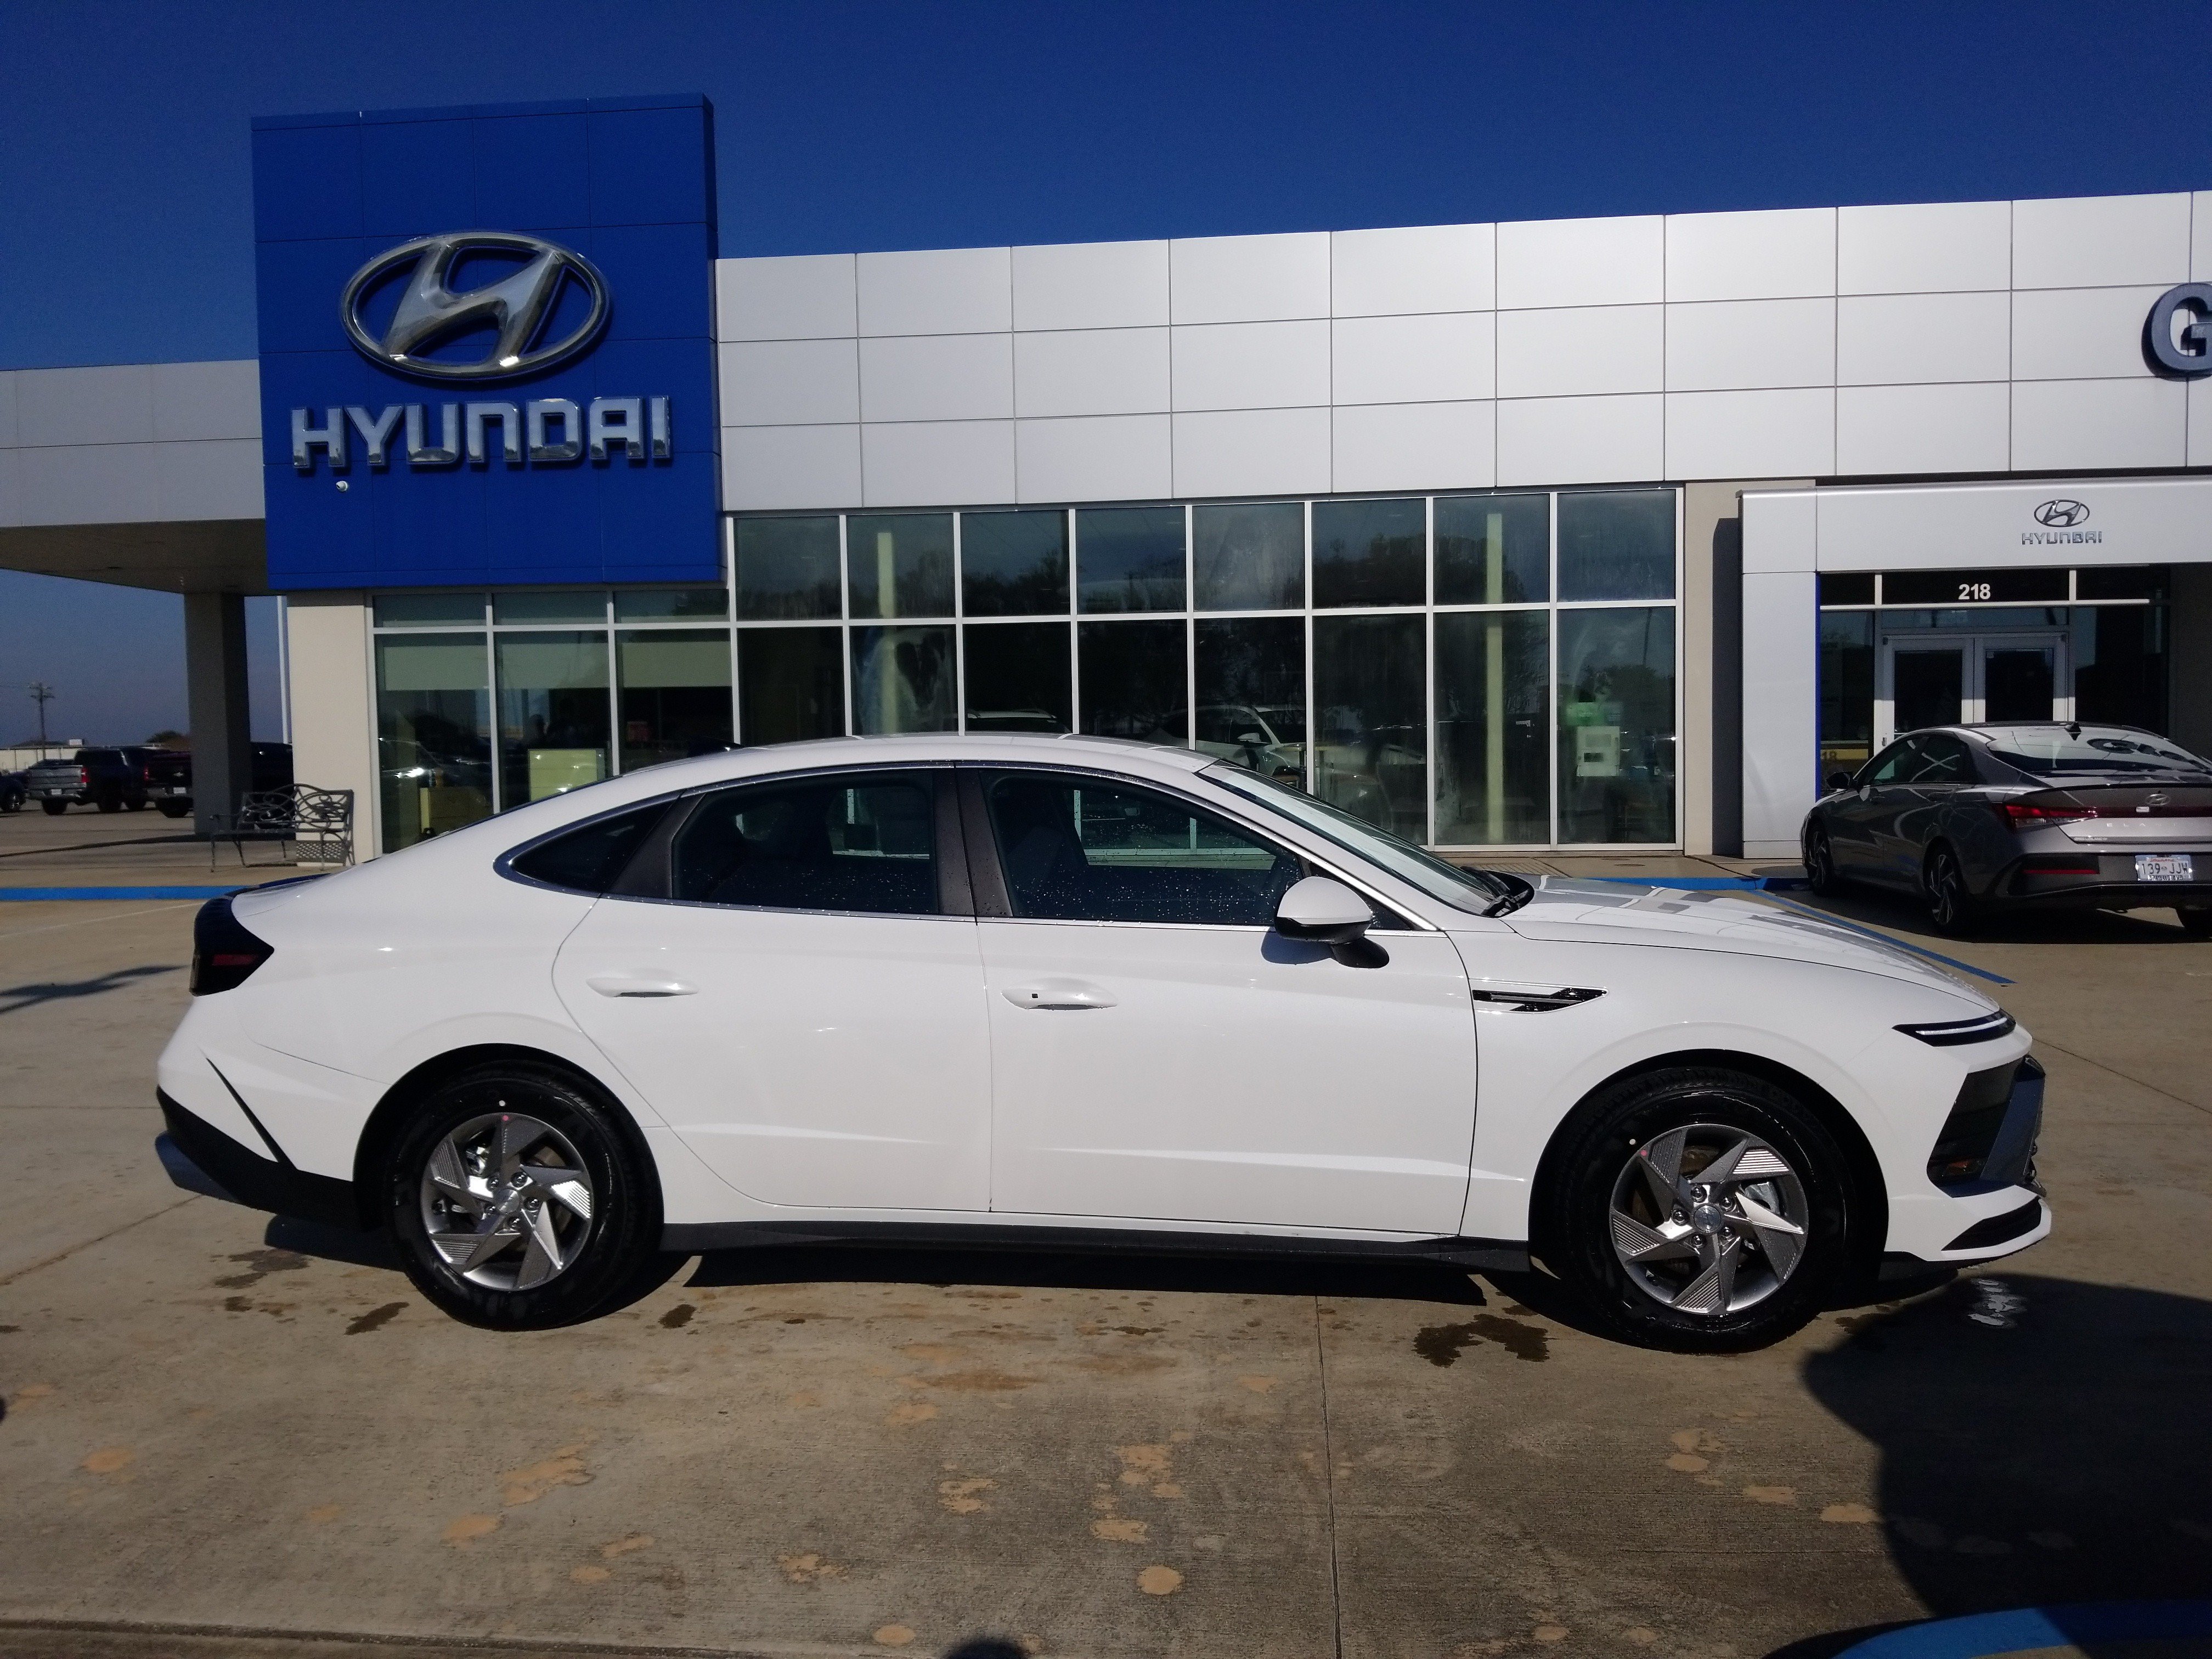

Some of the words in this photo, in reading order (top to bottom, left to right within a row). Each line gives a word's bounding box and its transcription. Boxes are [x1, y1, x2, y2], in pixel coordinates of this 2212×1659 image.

[291, 396, 672, 469] HYUNDAI
[2022, 531, 2102, 545] HYUNDAI
[1958, 583, 1991, 600] 218
